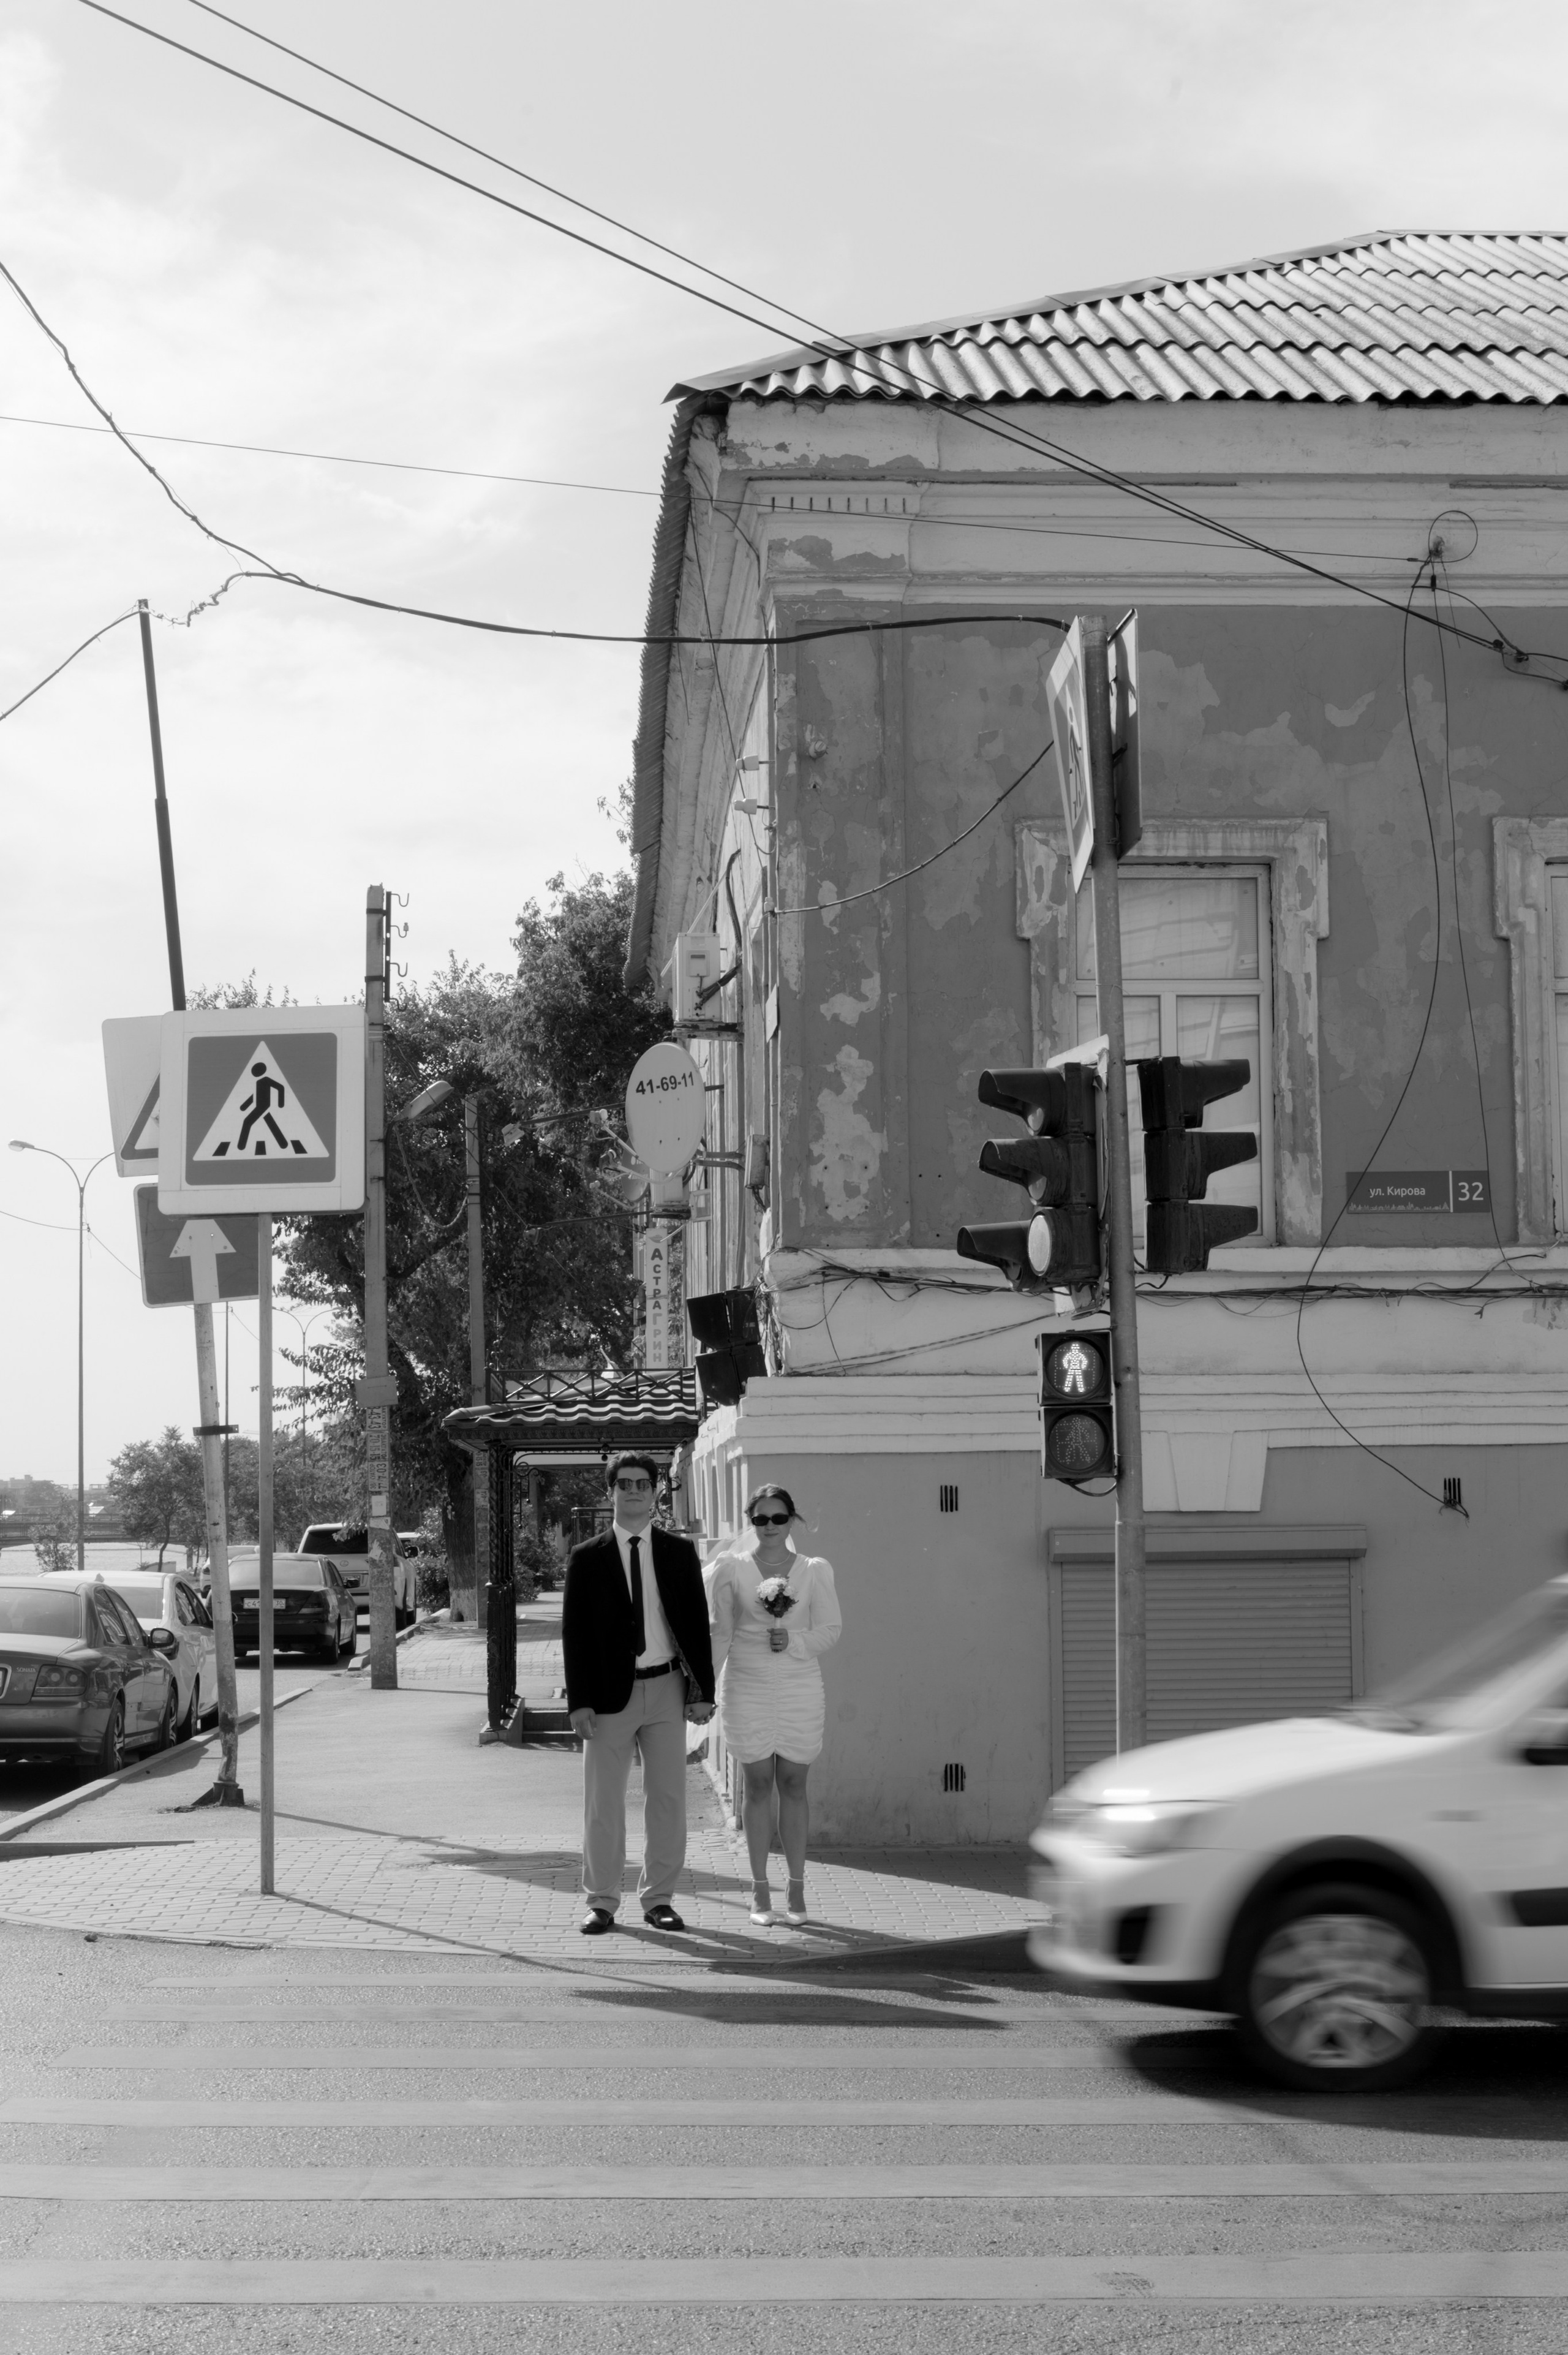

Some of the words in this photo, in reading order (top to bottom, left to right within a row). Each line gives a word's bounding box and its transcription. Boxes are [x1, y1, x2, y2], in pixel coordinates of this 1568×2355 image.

[636, 1071, 694, 1095] 41-69-11
[1369, 1188, 1385, 1198] ул.
[1387, 1186, 1426, 1198] Кирова
[1458, 1182, 1484, 1201] 32
[650, 1248, 663, 1363] АСТРАГРИН
